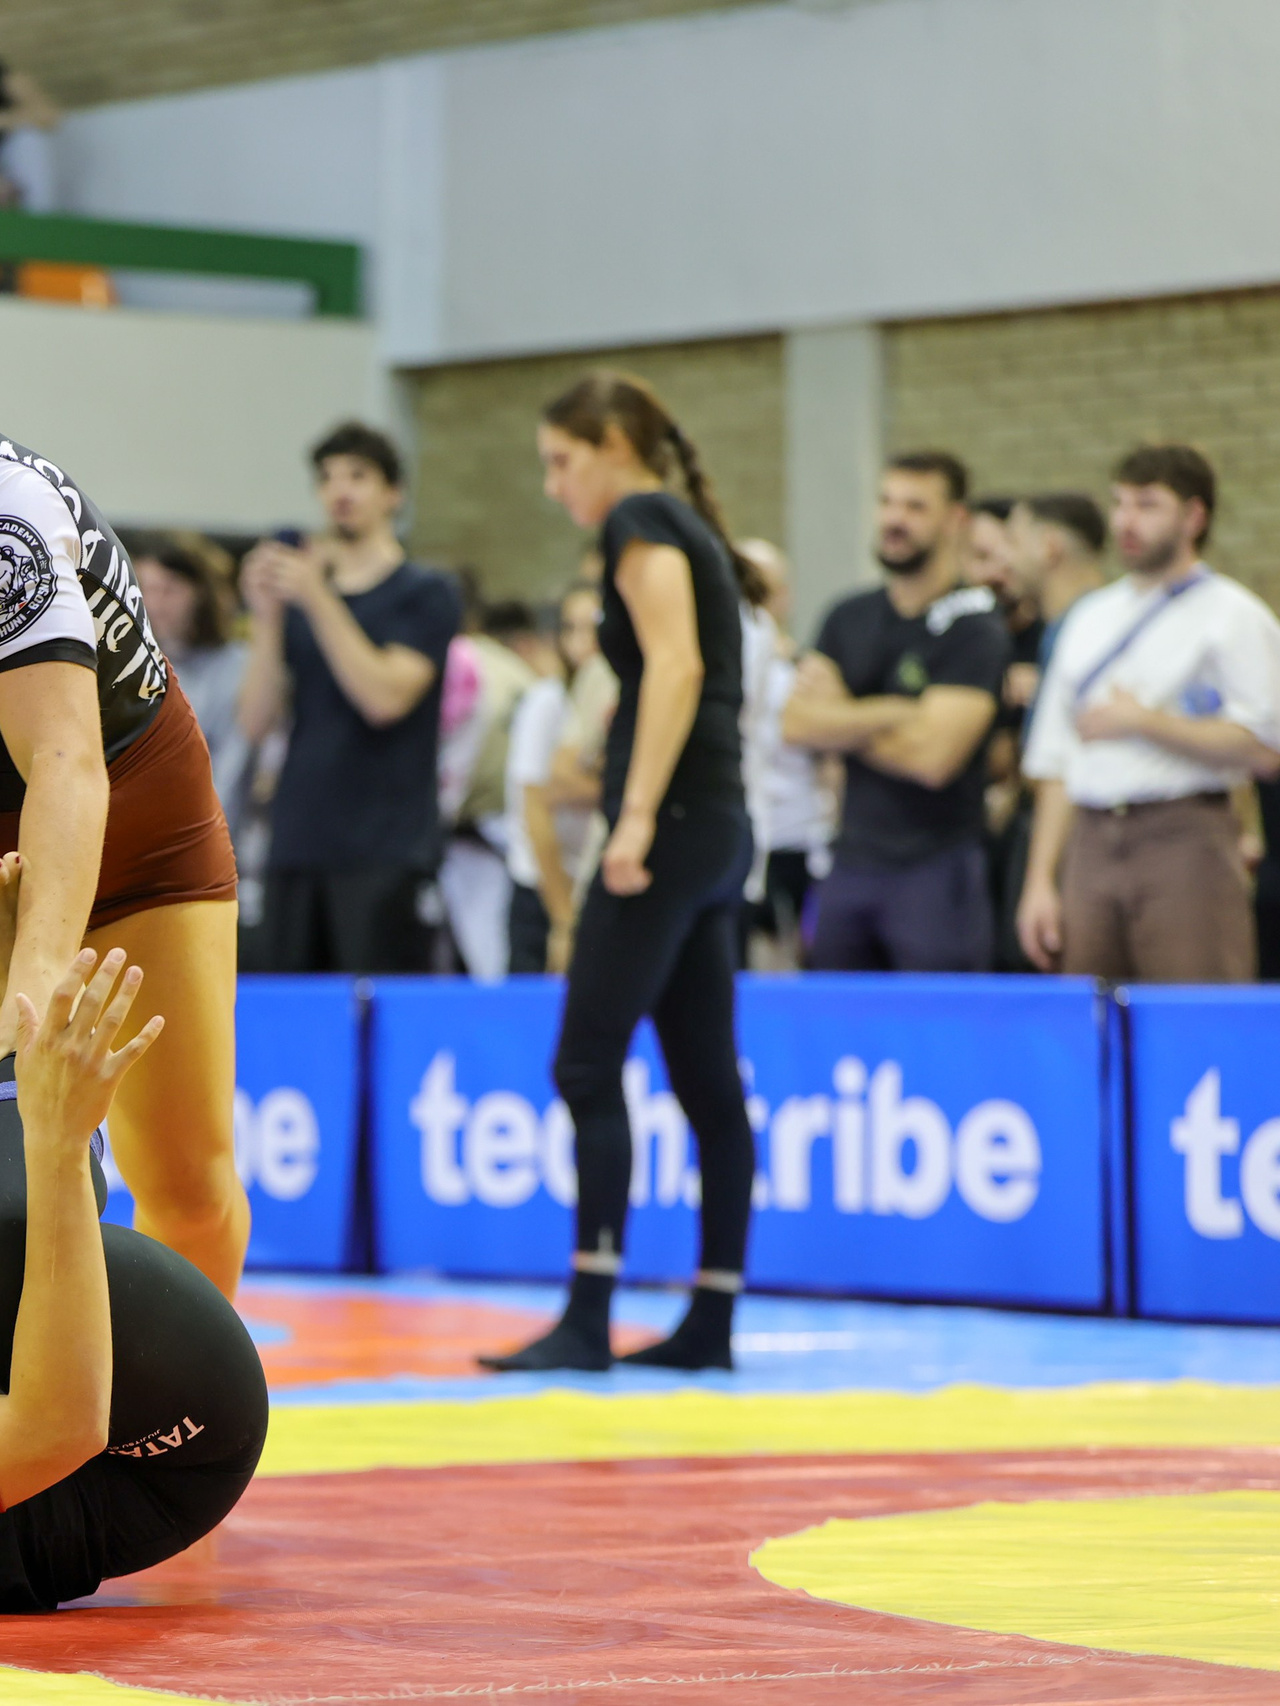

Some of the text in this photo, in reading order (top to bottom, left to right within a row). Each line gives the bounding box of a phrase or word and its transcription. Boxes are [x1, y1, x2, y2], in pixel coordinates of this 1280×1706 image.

[28, 573, 52, 610] BOSNIA
[408, 1046, 1042, 1223] tech.ribe
[108, 1415, 205, 1458] TATA
